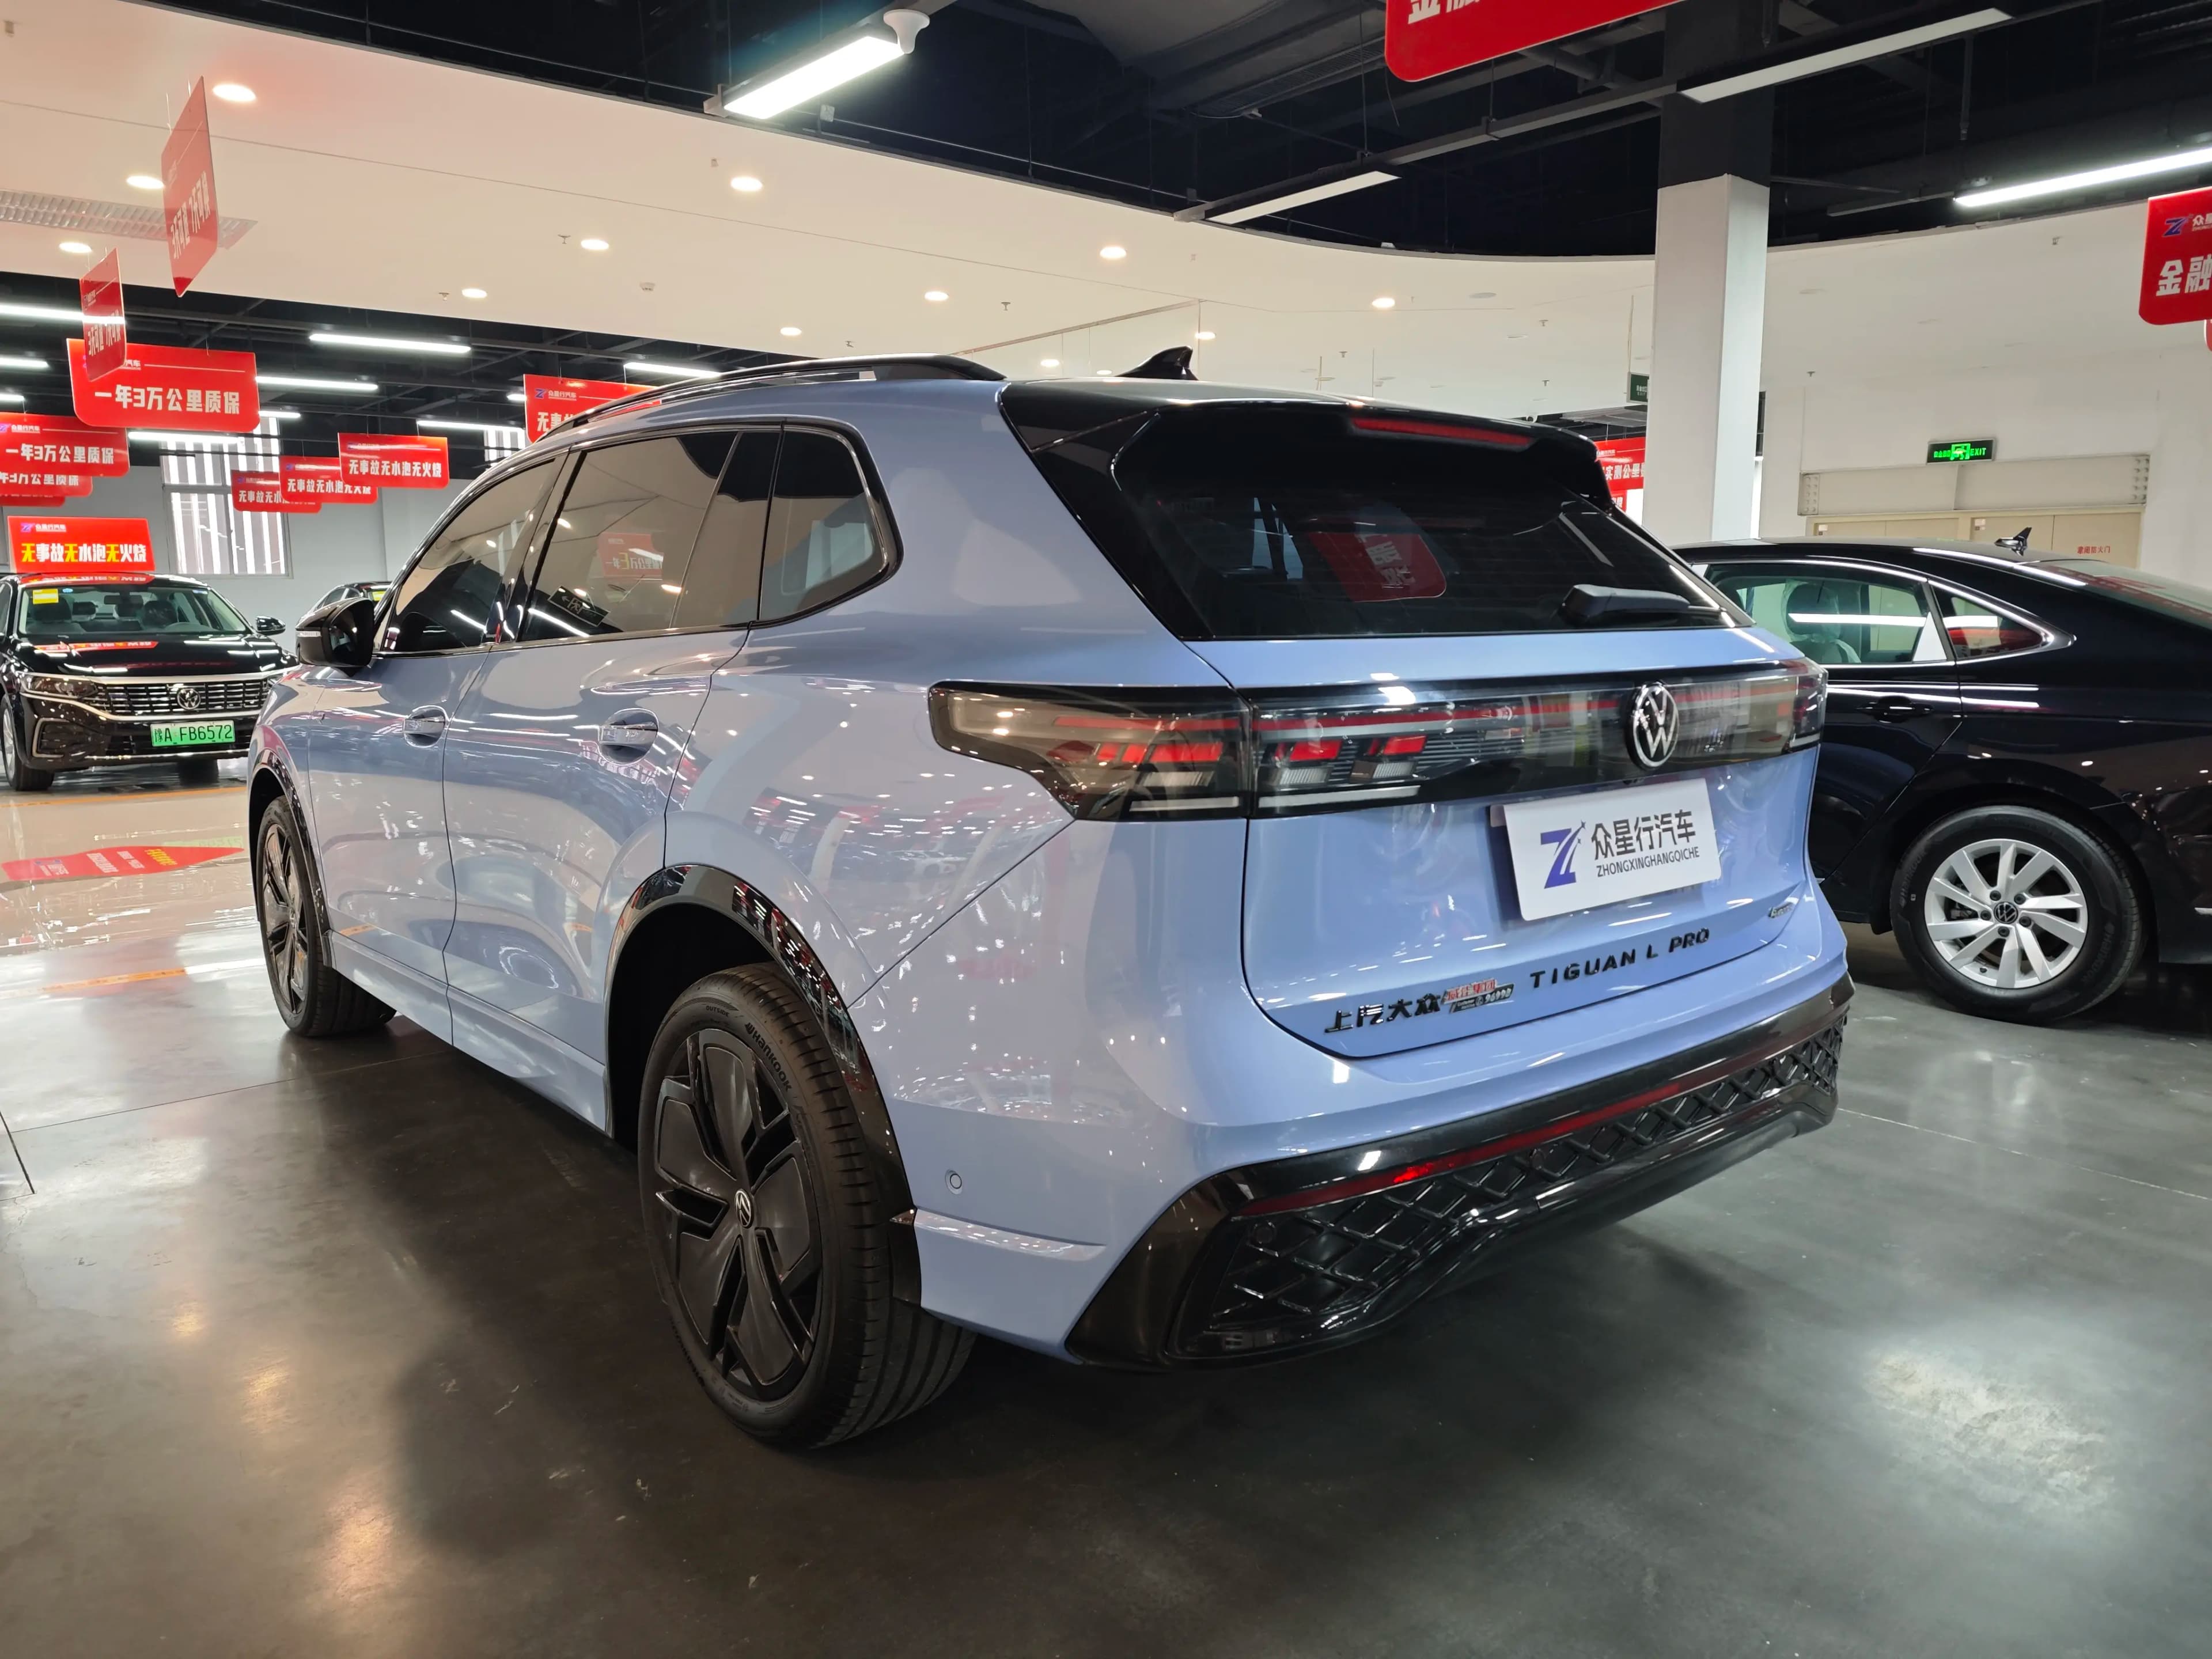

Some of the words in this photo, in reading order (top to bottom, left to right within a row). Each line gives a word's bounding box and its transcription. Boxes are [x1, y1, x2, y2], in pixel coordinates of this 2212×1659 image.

[94, 384, 240, 415] 一年3万公里质保
[6, 443, 114, 464] 一年3万公里质保
[1970, 448, 1986, 456] EXIT
[349, 460, 442, 478] 无事故无水泡无火烧
[1602, 462, 1645, 480] 实测公里
[21, 543, 146, 562] 无事故无水泡无火烧
[1591, 809, 1696, 860] 众星行汽车
[1596, 846, 1700, 877] ZHONGXINGHANGQICHE
[1529, 949, 1636, 988] TIGUAN
[1646, 944, 1658, 959] L
[1668, 927, 1710, 953] PRO
[706, 1005, 730, 1018] OUTSIDE
[1324, 993, 1441, 1033] 上汽大众
